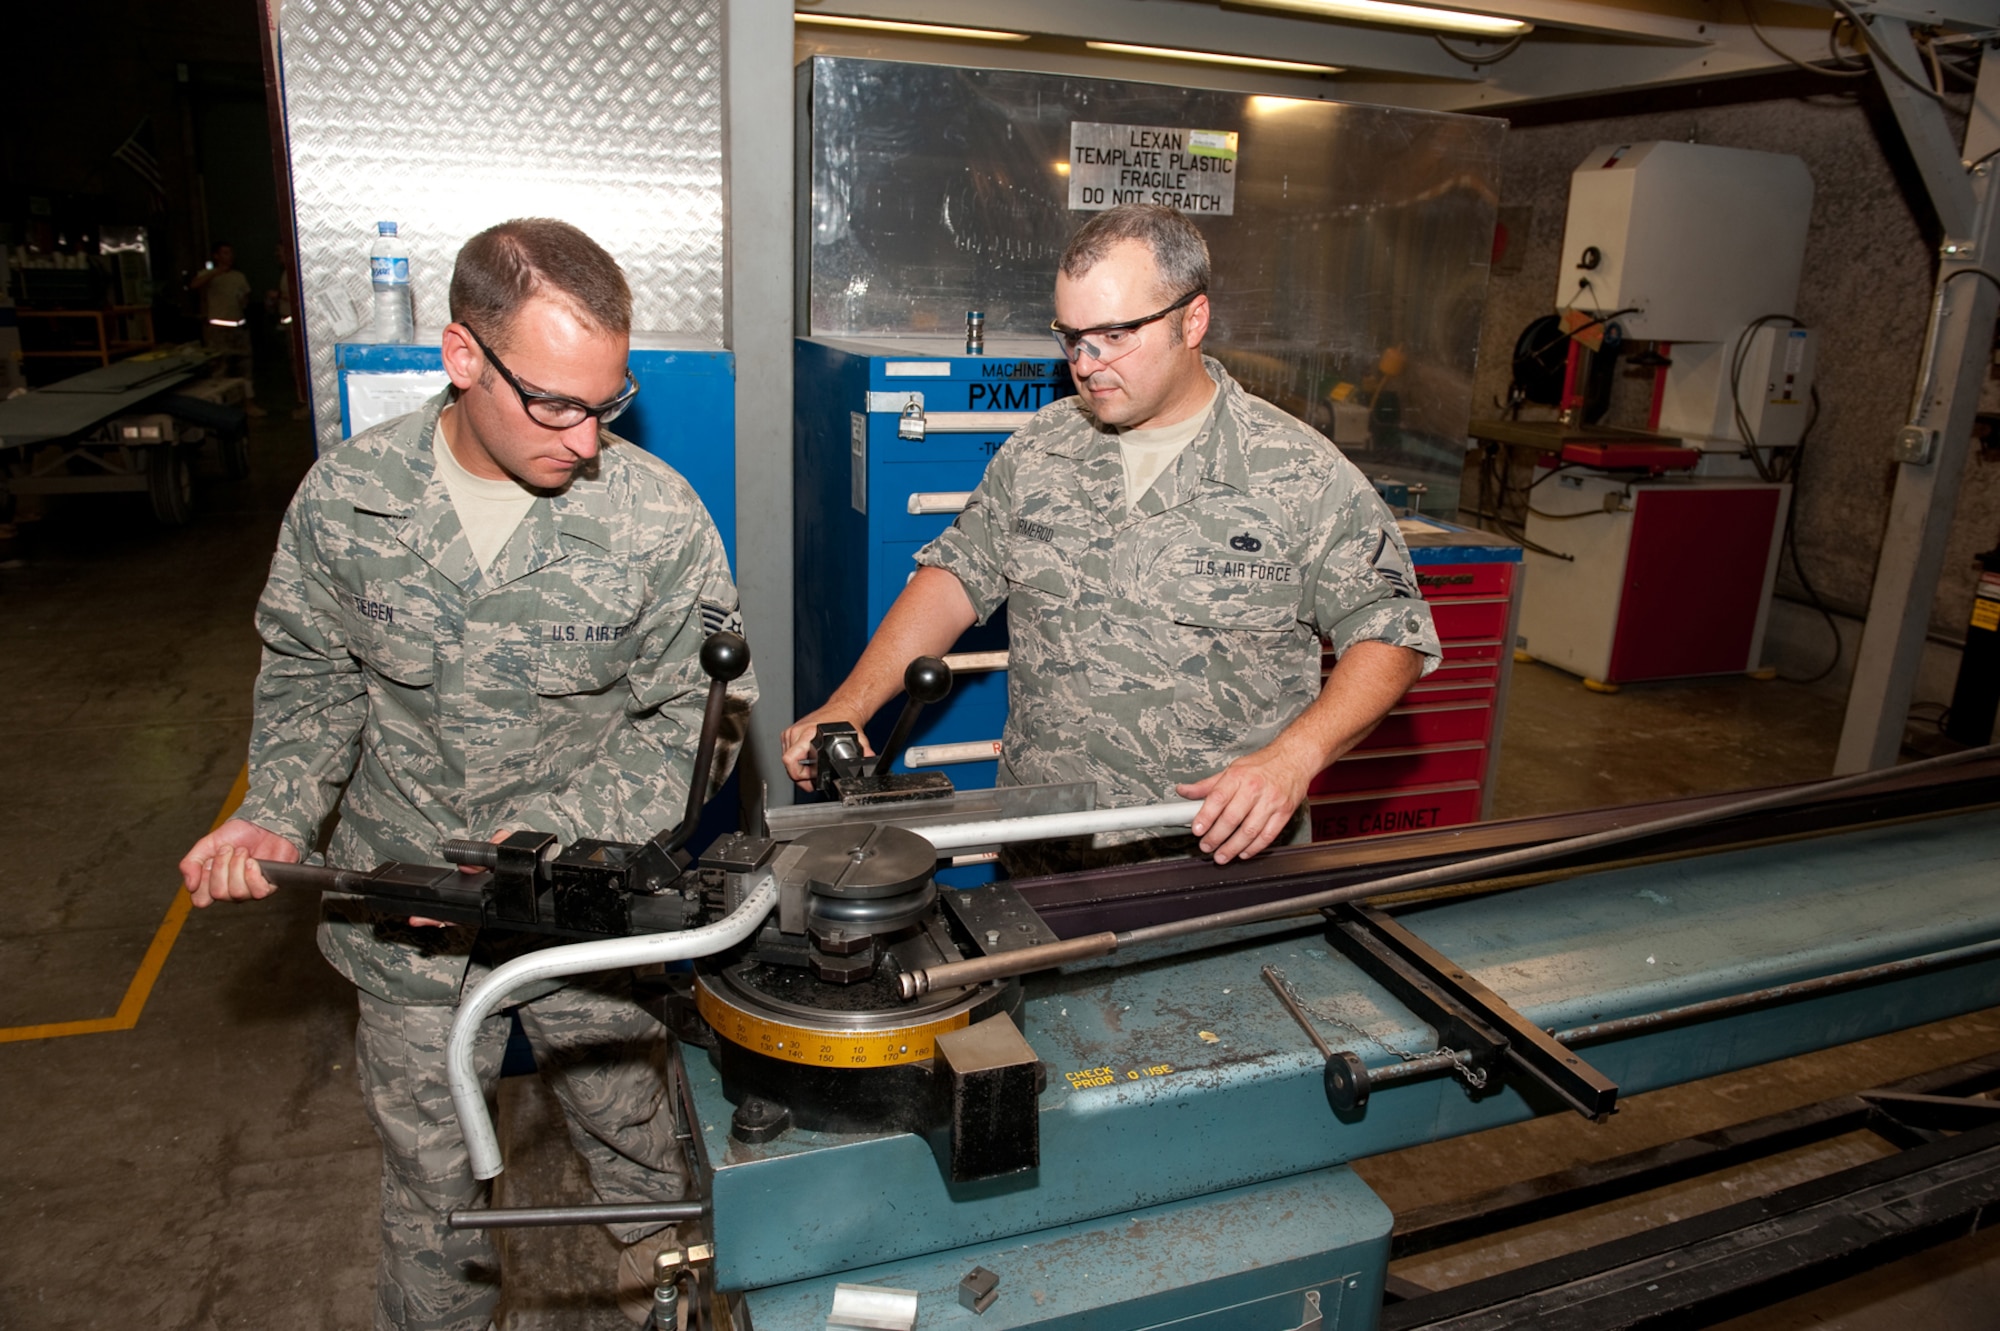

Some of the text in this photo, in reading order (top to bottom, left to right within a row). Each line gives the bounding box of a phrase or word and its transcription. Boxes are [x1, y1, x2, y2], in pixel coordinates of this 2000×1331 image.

[1130, 131, 1182, 150] LEXAN
[1075, 147, 1232, 174] TEMPLATE PLASTIC
[1120, 170, 1187, 190] FRAGILE
[1082, 187, 1221, 212] DO NOT SCRATCH
[982, 363, 1045, 377] MACHINE
[1195, 560, 1292, 582] U.S. AIR FORCE
[552, 625, 579, 641] U.S.
[585, 626, 609, 642] AIR
[1359, 807, 1441, 833] CABINET
[760, 1042, 774, 1052] 130
[788, 1049, 803, 1059] 140
[818, 1053, 834, 1063] 150
[850, 1054, 866, 1063] 160
[882, 1052, 899, 1062] 170
[914, 1048, 930, 1057] 180
[761, 1034, 771, 1042] 40
[789, 1041, 800, 1049] 30
[820, 1045, 831, 1053] 20
[853, 1046, 864, 1054] 10
[887, 1044, 894, 1052] 0
[1065, 1066, 1115, 1081] CHECK
[1071, 1074, 1116, 1090] PRIOR
[1141, 1063, 1175, 1077] USE
